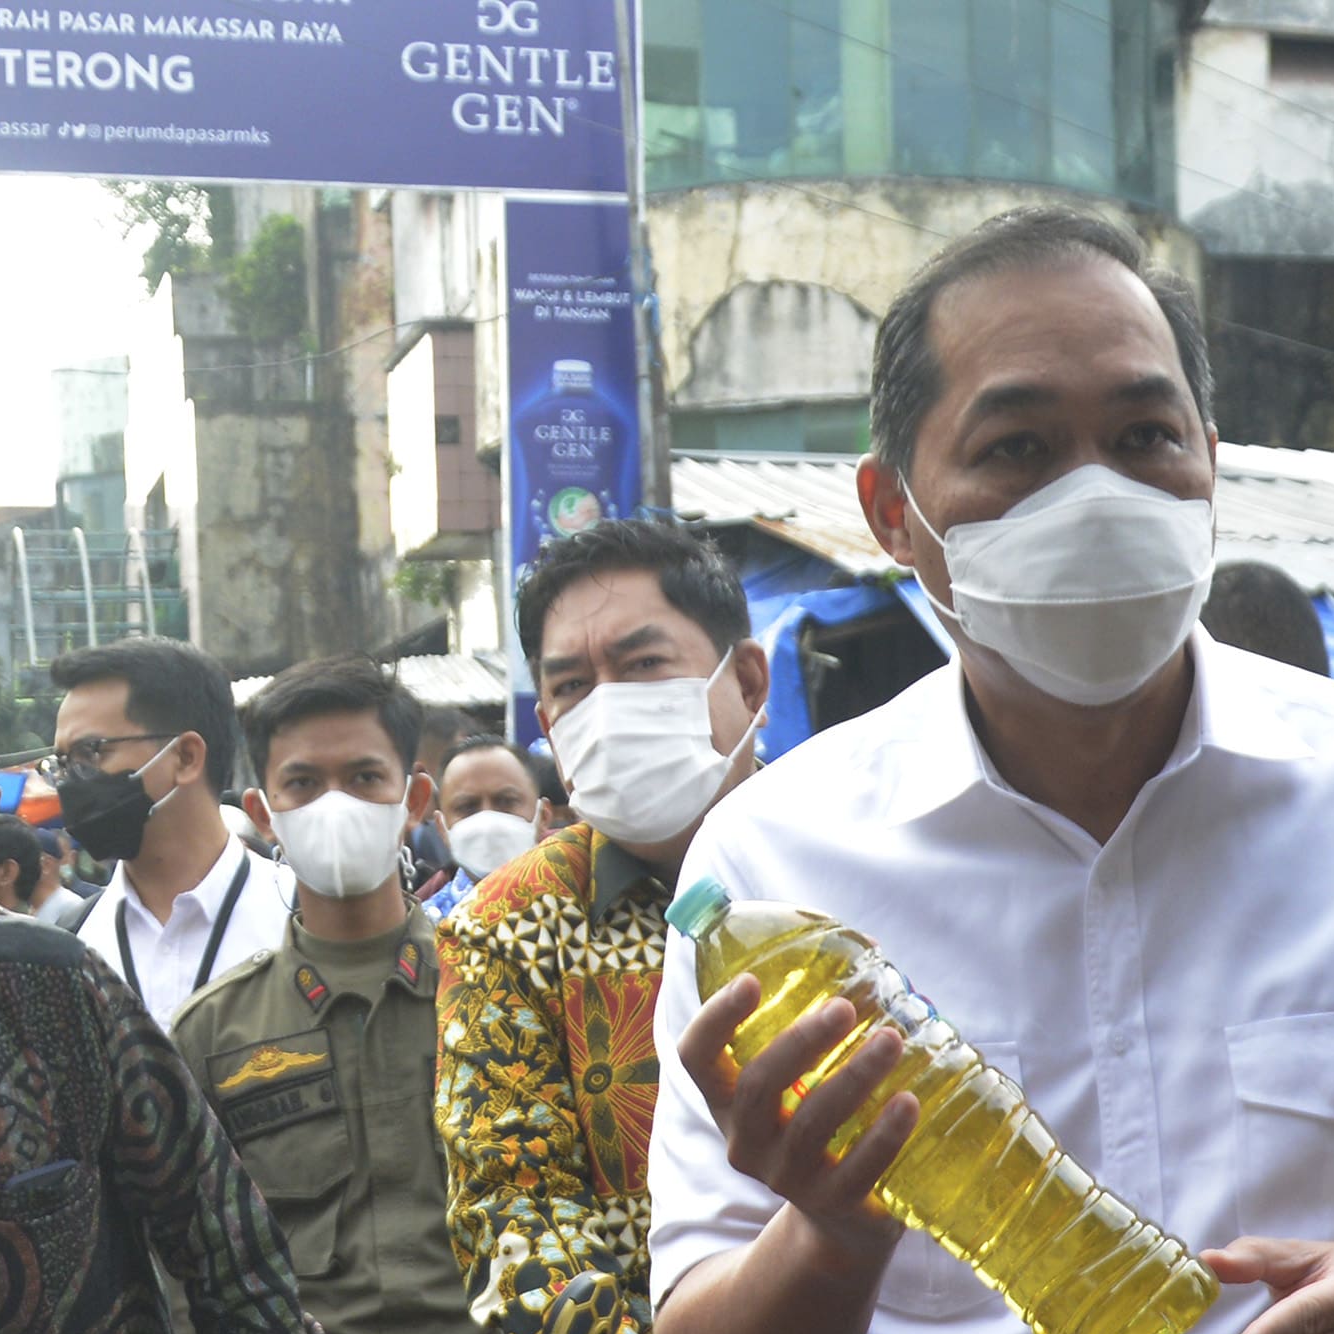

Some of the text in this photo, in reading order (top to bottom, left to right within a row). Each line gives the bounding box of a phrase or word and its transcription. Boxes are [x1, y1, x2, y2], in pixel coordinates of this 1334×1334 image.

[58, 9, 136, 34] PASAR
[143, 14, 276, 41] MAKASSAR
[282, 20, 344, 45] RAYA
[401, 41, 616, 91] GENTLE
[577, 291, 630, 306] LEMBUT
[534, 304, 611, 321] DI TANGAN
[533, 424, 613, 442] GENTLE
[553, 441, 595, 458] GEN
